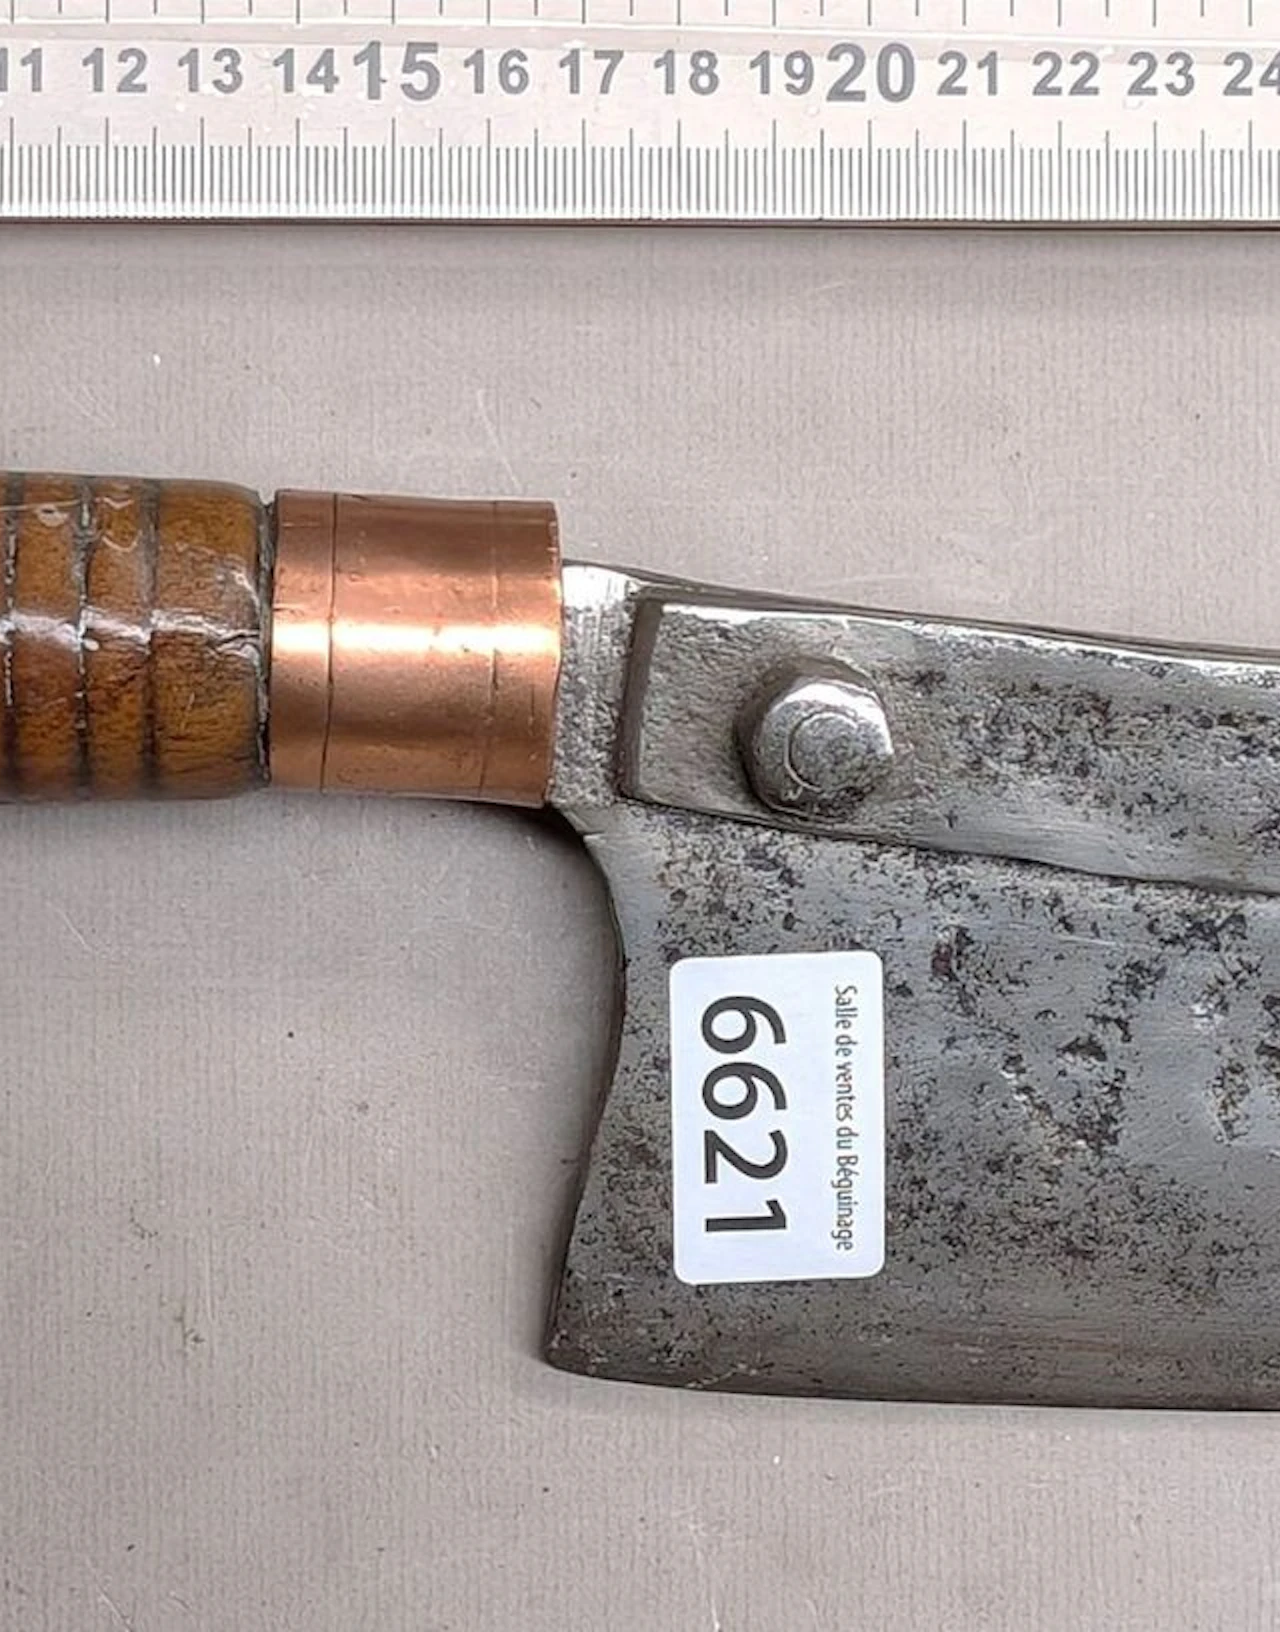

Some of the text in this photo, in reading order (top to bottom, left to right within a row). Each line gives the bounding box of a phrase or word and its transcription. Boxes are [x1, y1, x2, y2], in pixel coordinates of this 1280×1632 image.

[82, 47, 148, 93] 12
[177, 48, 244, 95] 13
[273, 48, 340, 94] 14
[353, 41, 441, 101] 15
[464, 48, 530, 95] 16
[558, 48, 624, 95] 17
[654, 49, 720, 96] 18
[749, 48, 815, 96] 19
[826, 42, 916, 103] 20
[936, 50, 999, 96] 21
[1031, 50, 1100, 96] 22
[1127, 50, 1195, 96] 23
[701, 996, 788, 1232] 6621
[830, 984, 859, 1251] Salle de ventes du Béguinage
